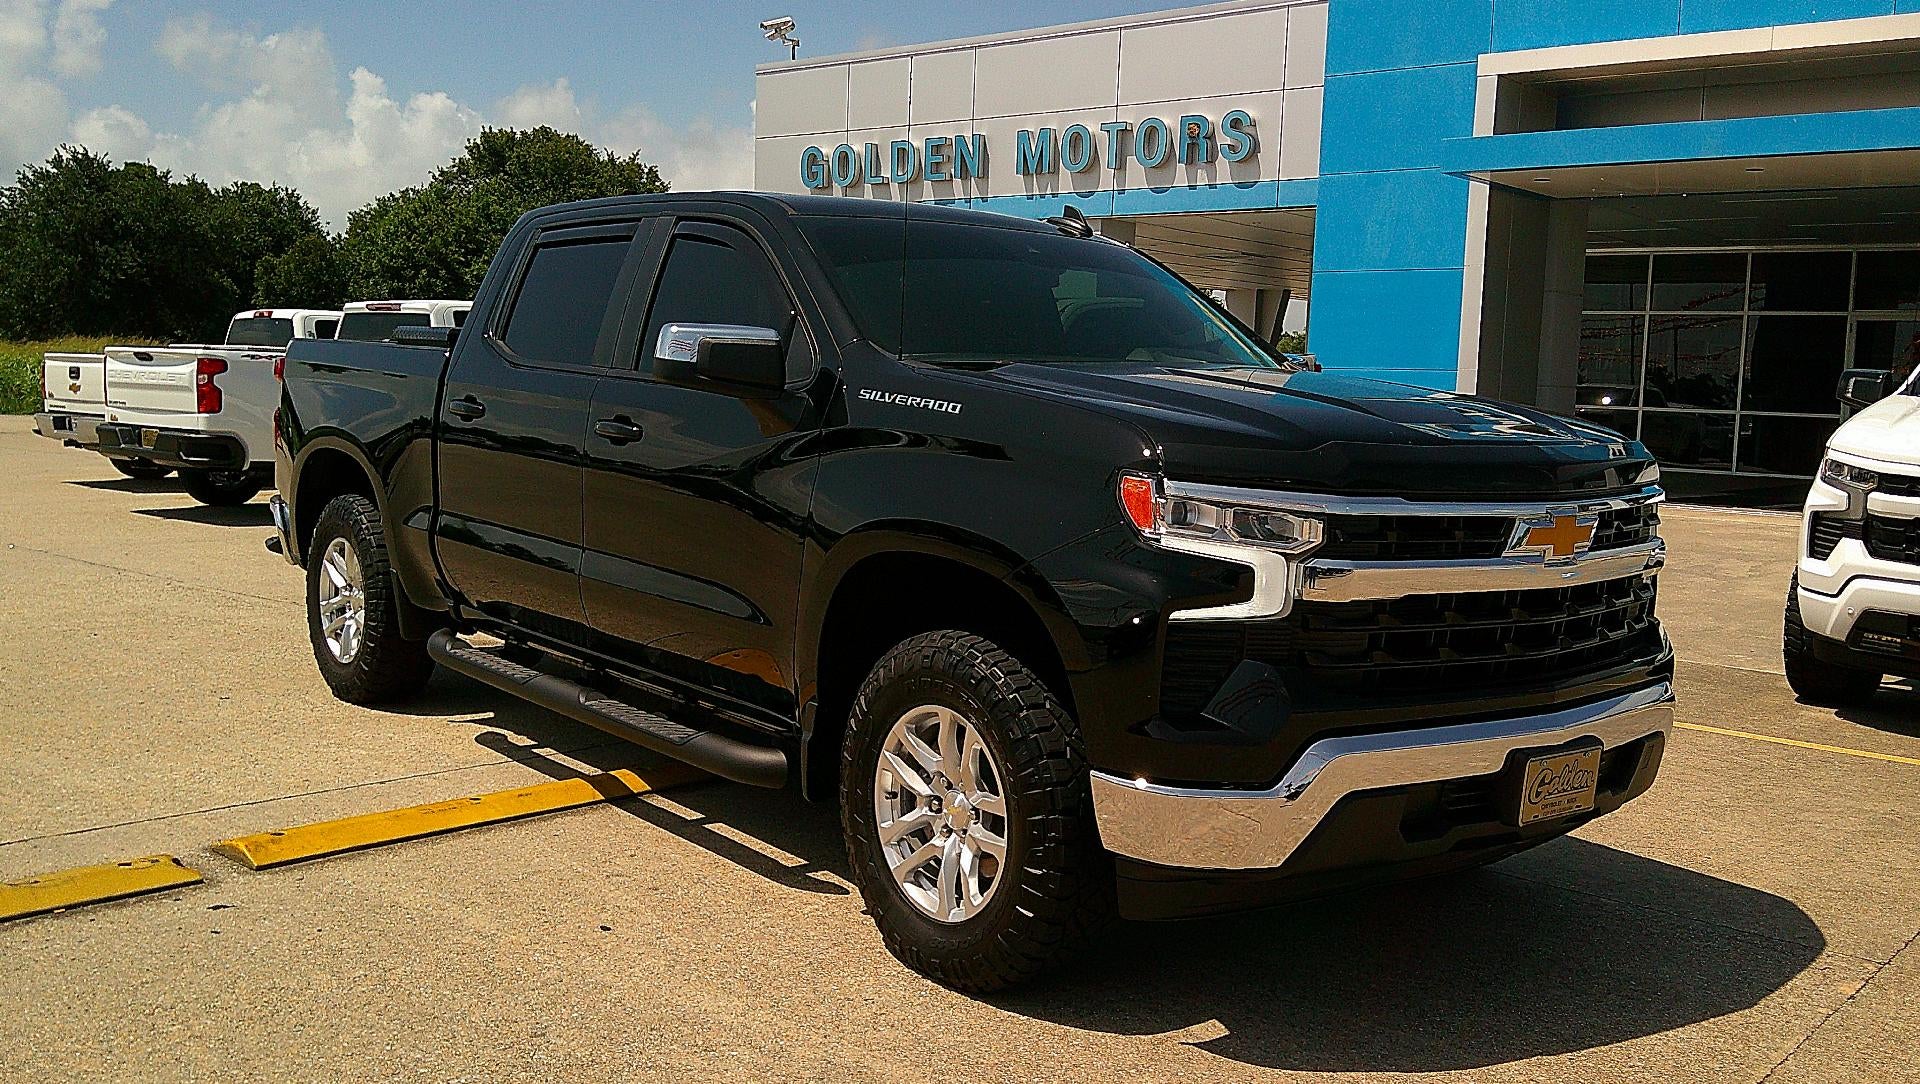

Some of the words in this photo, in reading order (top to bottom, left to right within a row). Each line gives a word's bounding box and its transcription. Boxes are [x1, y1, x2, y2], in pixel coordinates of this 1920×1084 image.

[800, 133, 985, 189] GOLDEN
[1015, 109, 1258, 176] MOTORS
[858, 388, 963, 414] SILVERADO
[1528, 758, 1595, 805] Golden
